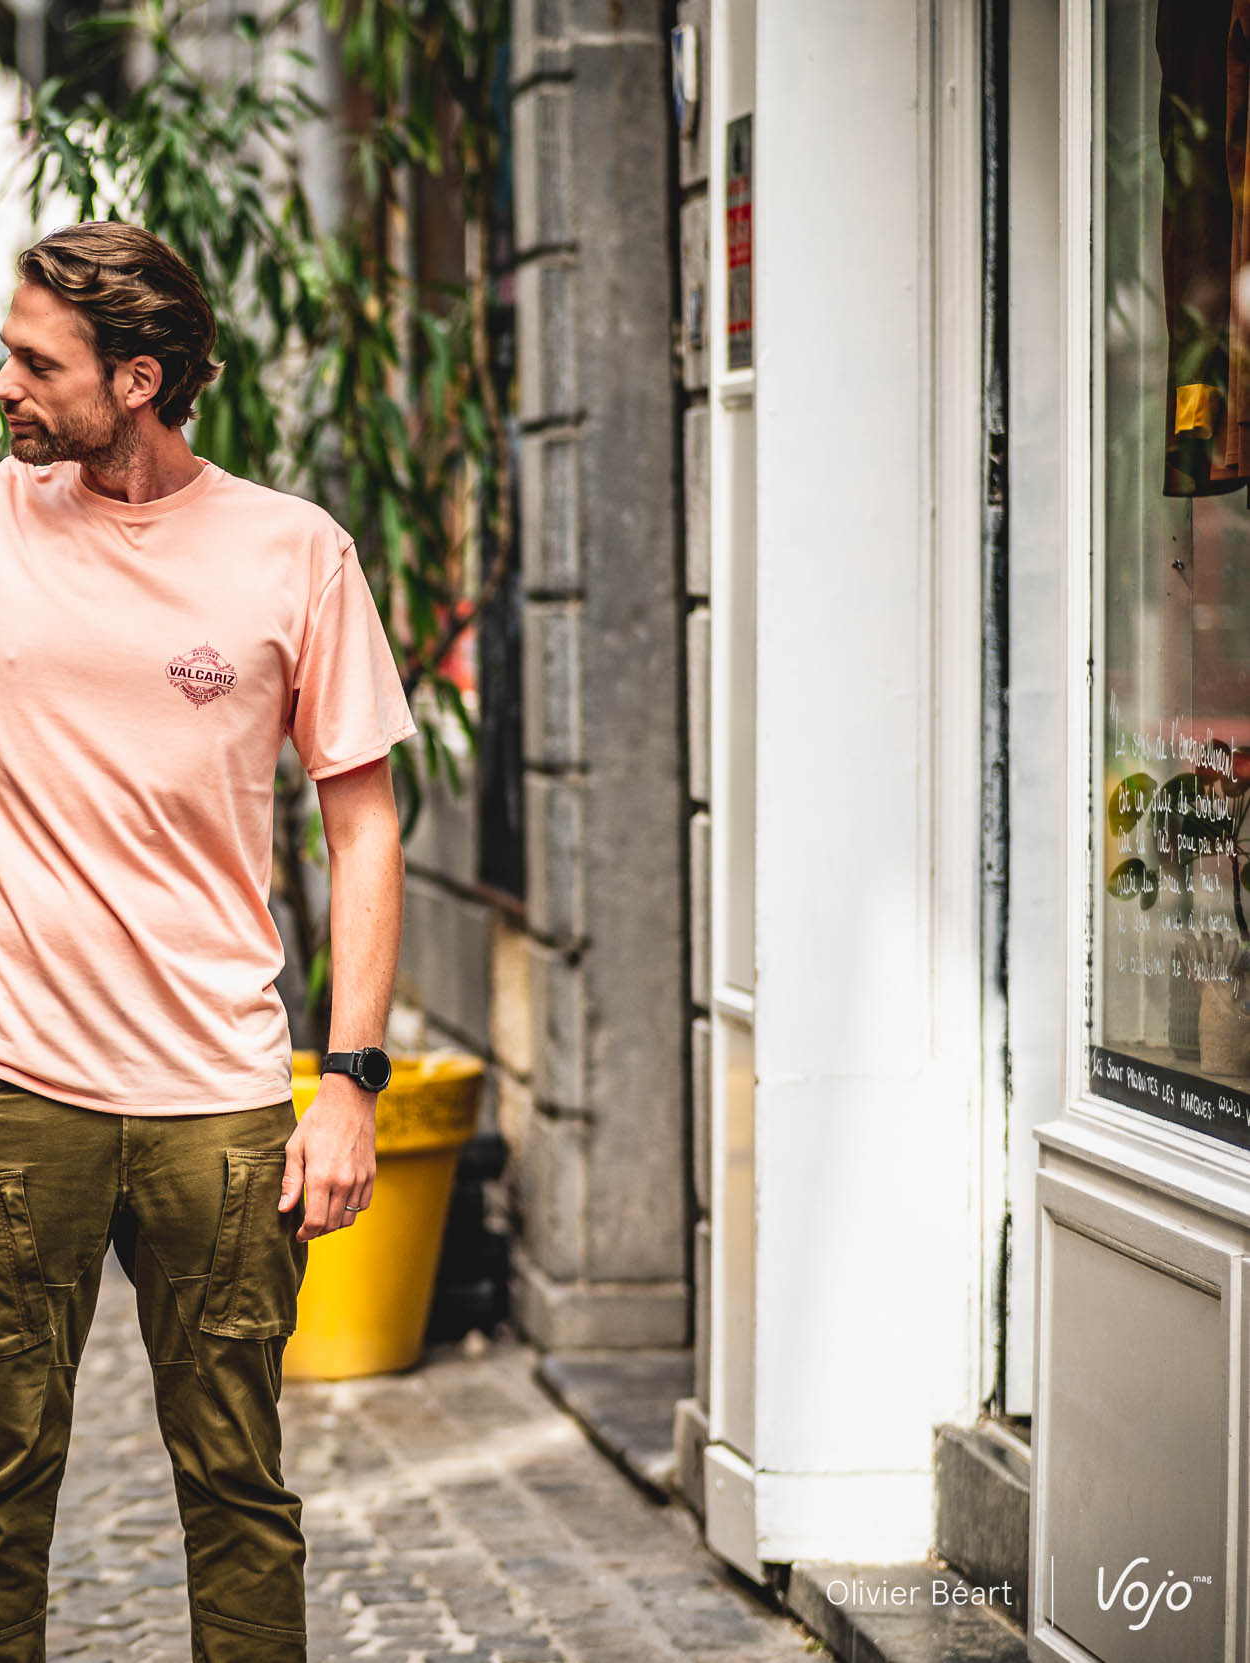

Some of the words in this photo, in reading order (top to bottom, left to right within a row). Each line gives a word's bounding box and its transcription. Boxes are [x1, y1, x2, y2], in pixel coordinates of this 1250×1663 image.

[169, 665, 235, 686] VALCARIZ
[1178, 781, 1188, 816] de
[1177, 834, 1197, 864] pour
[1162, 1084, 1175, 1105] LES
